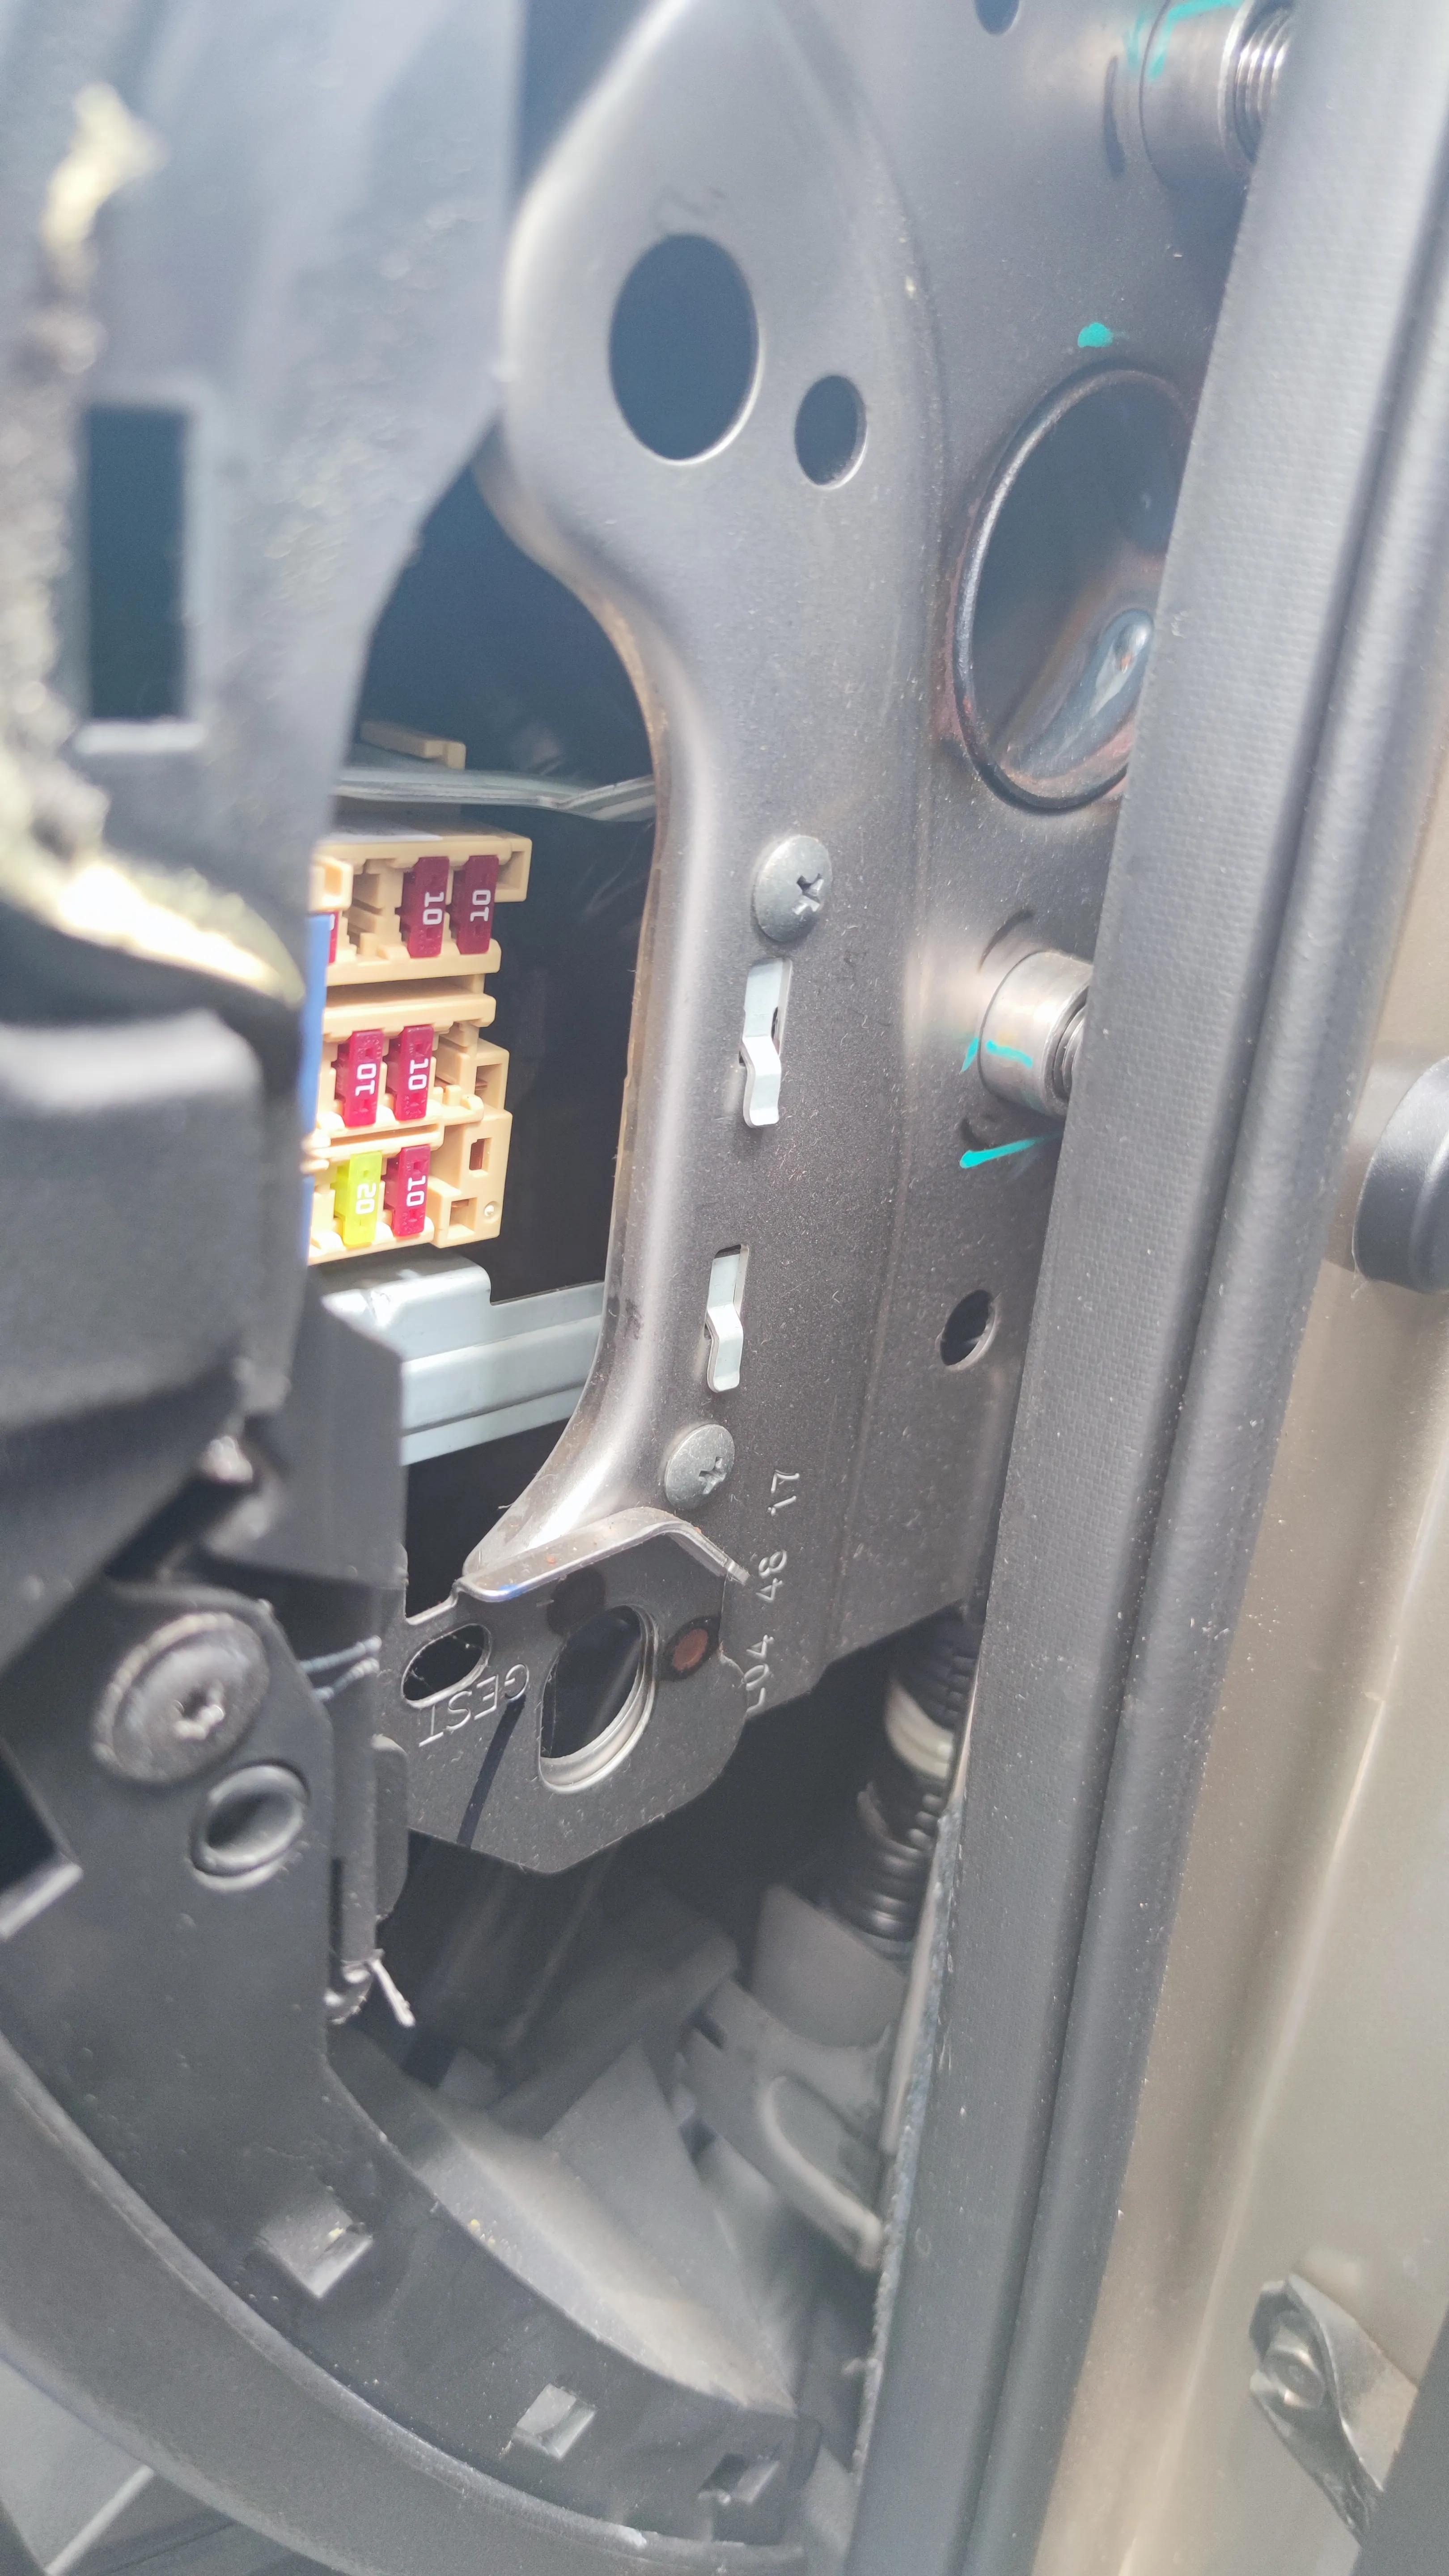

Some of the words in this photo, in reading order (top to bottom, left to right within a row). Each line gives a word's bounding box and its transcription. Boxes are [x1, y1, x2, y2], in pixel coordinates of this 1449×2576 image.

[422, 891, 444, 925] 10
[470, 889, 491, 922] 10
[355, 1062, 377, 1096] 10
[407, 1057, 428, 1091] 10
[355, 1182, 376, 1214] 20
[407, 1174, 426, 1207] 10
[767, 1469, 800, 1514] 17
[756, 1551, 787, 1602] 48
[419, 1663, 530, 1748] GEST
